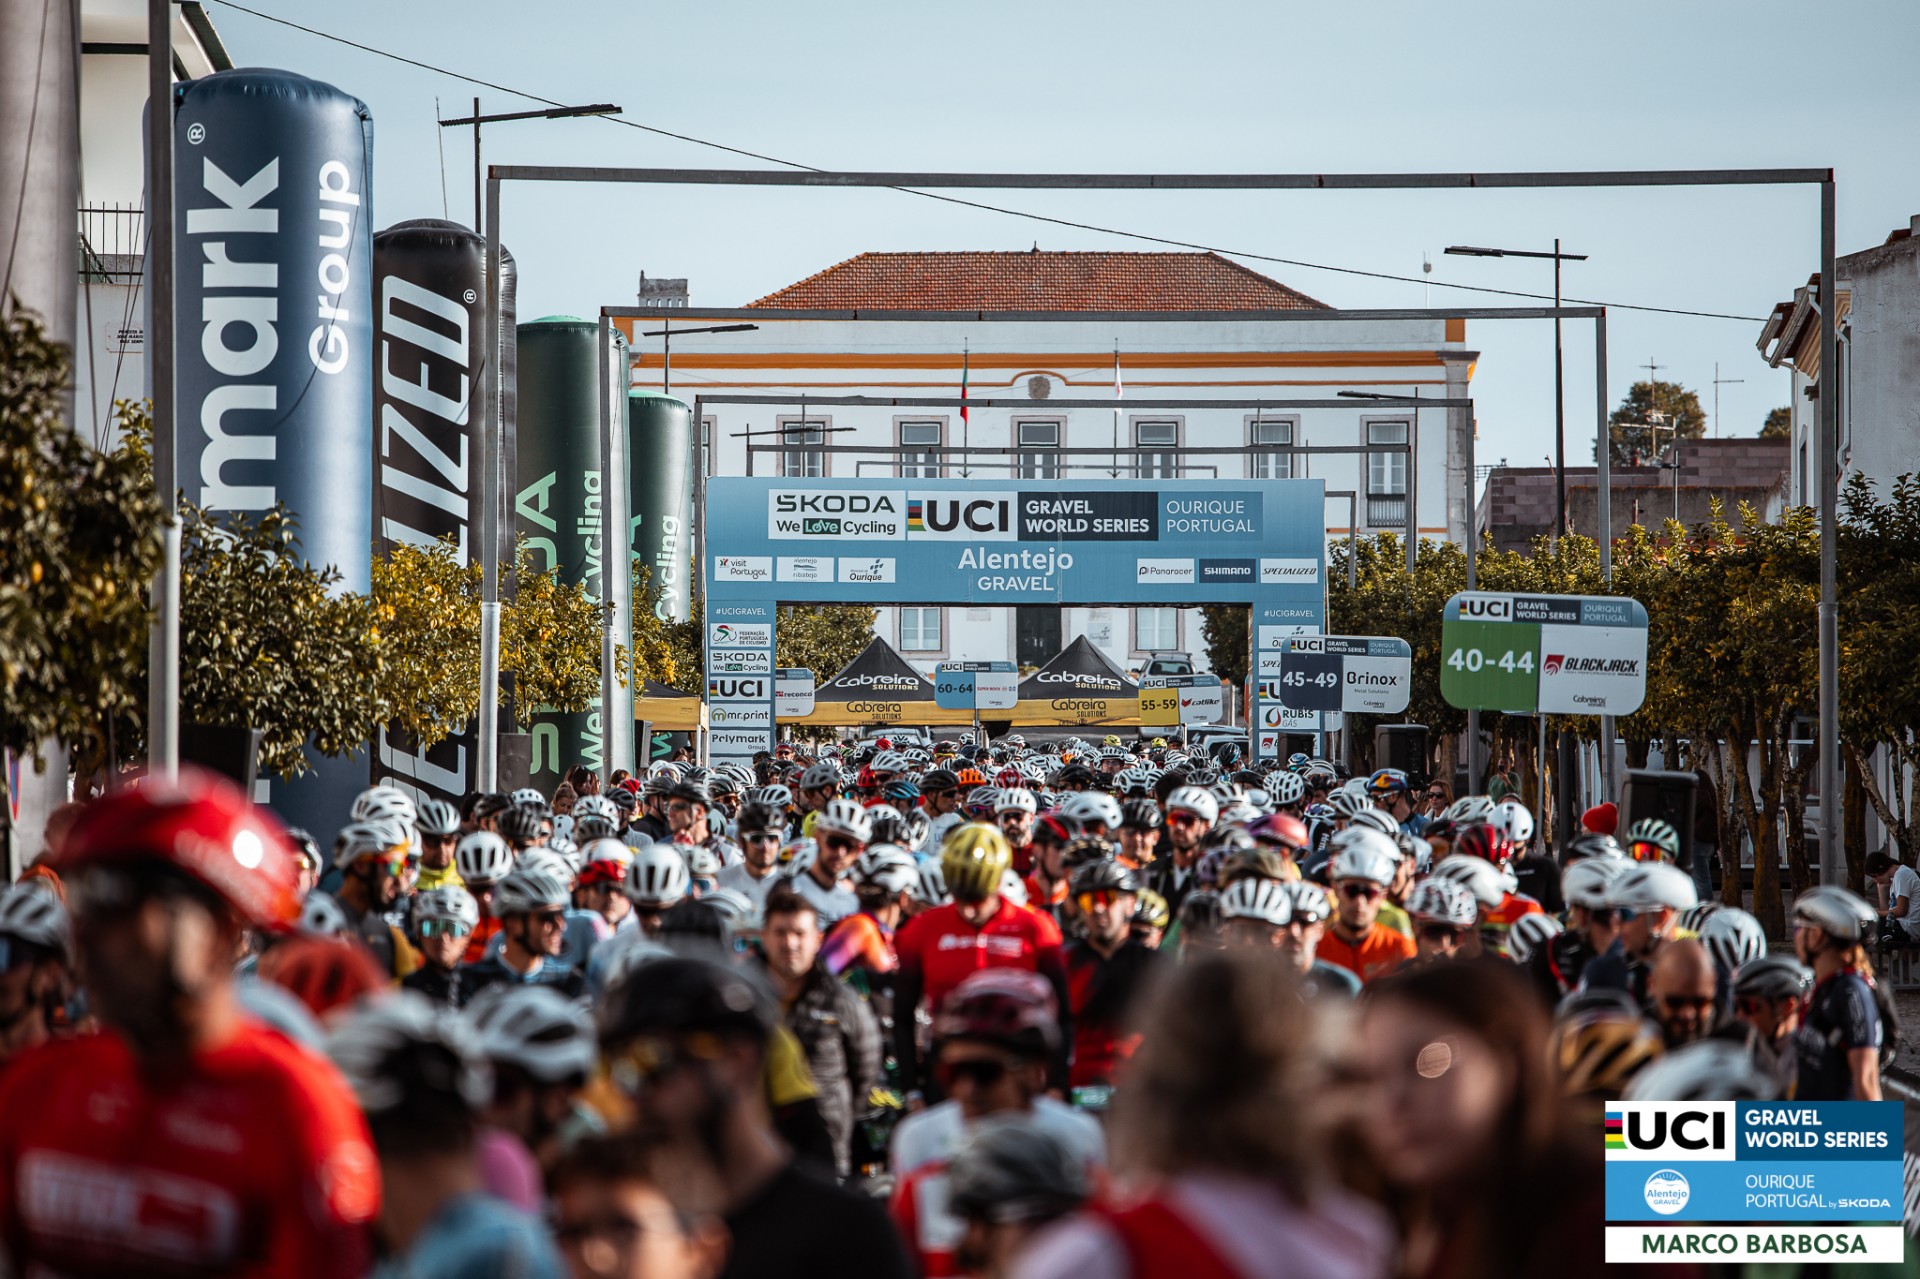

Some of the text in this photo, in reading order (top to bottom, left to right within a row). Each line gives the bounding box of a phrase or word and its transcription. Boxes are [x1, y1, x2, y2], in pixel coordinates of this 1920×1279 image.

[308, 160, 360, 375] Group
[1026, 500, 1094, 515] GRAVEL
[1166, 500, 1245, 515] OURIQUE
[926, 499, 1009, 533] UCI
[776, 519, 896, 535] We Love Cycling
[1026, 518, 1150, 533] WORLD SERIES
[1166, 519, 1256, 533] PORTUGAL
[731, 559, 747, 567] visit
[958, 547, 1073, 576] Alentejo
[655, 515, 681, 621] Cycling
[730, 568, 767, 579] Portugal
[1150, 566, 1193, 575] Panaracer
[1204, 567, 1251, 575] SHIMANO
[1261, 567, 1317, 575] SPECIALIZED
[850, 573, 882, 582] Ourique
[977, 576, 1054, 591] GRAVEL
[715, 607, 766, 616] #UCIGRAVEL
[1468, 600, 1509, 617] UCI
[1516, 602, 1550, 611] GRAVEL
[1584, 604, 1623, 614] OURIQUE
[1264, 609, 1315, 618] #UCIGRAVEL
[1516, 611, 1577, 621] WORLD SERIES
[1584, 613, 1628, 623] PORTUGAL
[1297, 640, 1323, 651] UCI
[1447, 648, 1535, 674] 40-44
[1565, 657, 1638, 673] BLACKJACK
[743, 664, 768, 672] Cycling
[945, 663, 962, 671] UCI
[834, 673, 920, 687] Cabreira
[1036, 670, 1121, 687] Cabreira
[1148, 679, 1165, 688] UCI
[1283, 671, 1338, 688] 45-49
[1346, 671, 1397, 686] Brinox
[719, 680, 763, 697] UCI
[938, 683, 973, 694] 60-64
[1075, 682, 1121, 691] SOLUTIONS
[846, 701, 902, 713] Cabreira
[1051, 699, 1107, 711] Cabreira
[1141, 698, 1177, 711] 55-59
[1192, 698, 1220, 706] catlike
[727, 710, 769, 721] mr.print
[1077, 710, 1107, 718] SOLUTIONS
